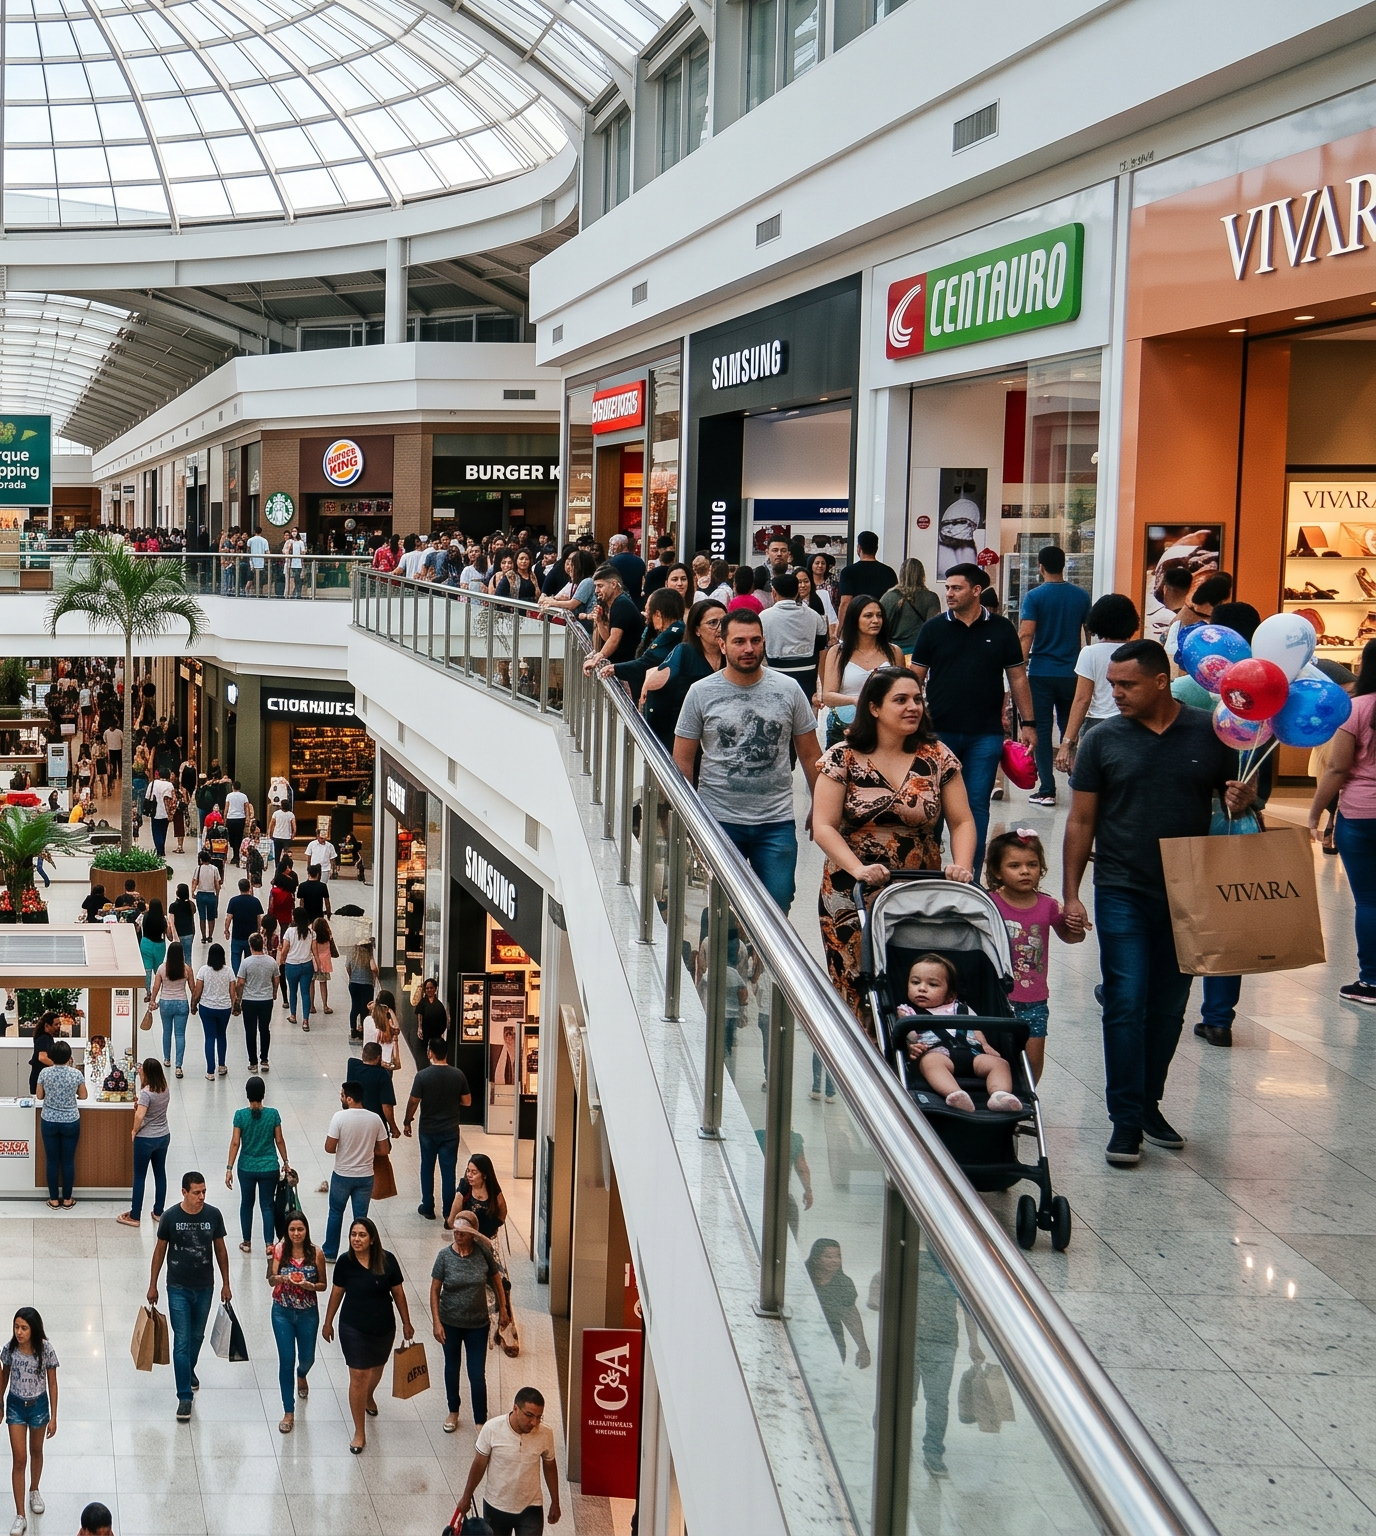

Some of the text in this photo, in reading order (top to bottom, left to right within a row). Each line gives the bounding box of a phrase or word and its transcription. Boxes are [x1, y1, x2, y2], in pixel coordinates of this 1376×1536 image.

[929, 241, 1067, 337] CENTAURO
[712, 340, 781, 390] SAMSUNG
[329, 455, 358, 476] KING
[465, 465, 544, 480] BURGER
[465, 845, 516, 921] SAMSUNG
[1216, 880, 1301, 902] VIVARA
[593, 1343, 630, 1411] C&A
